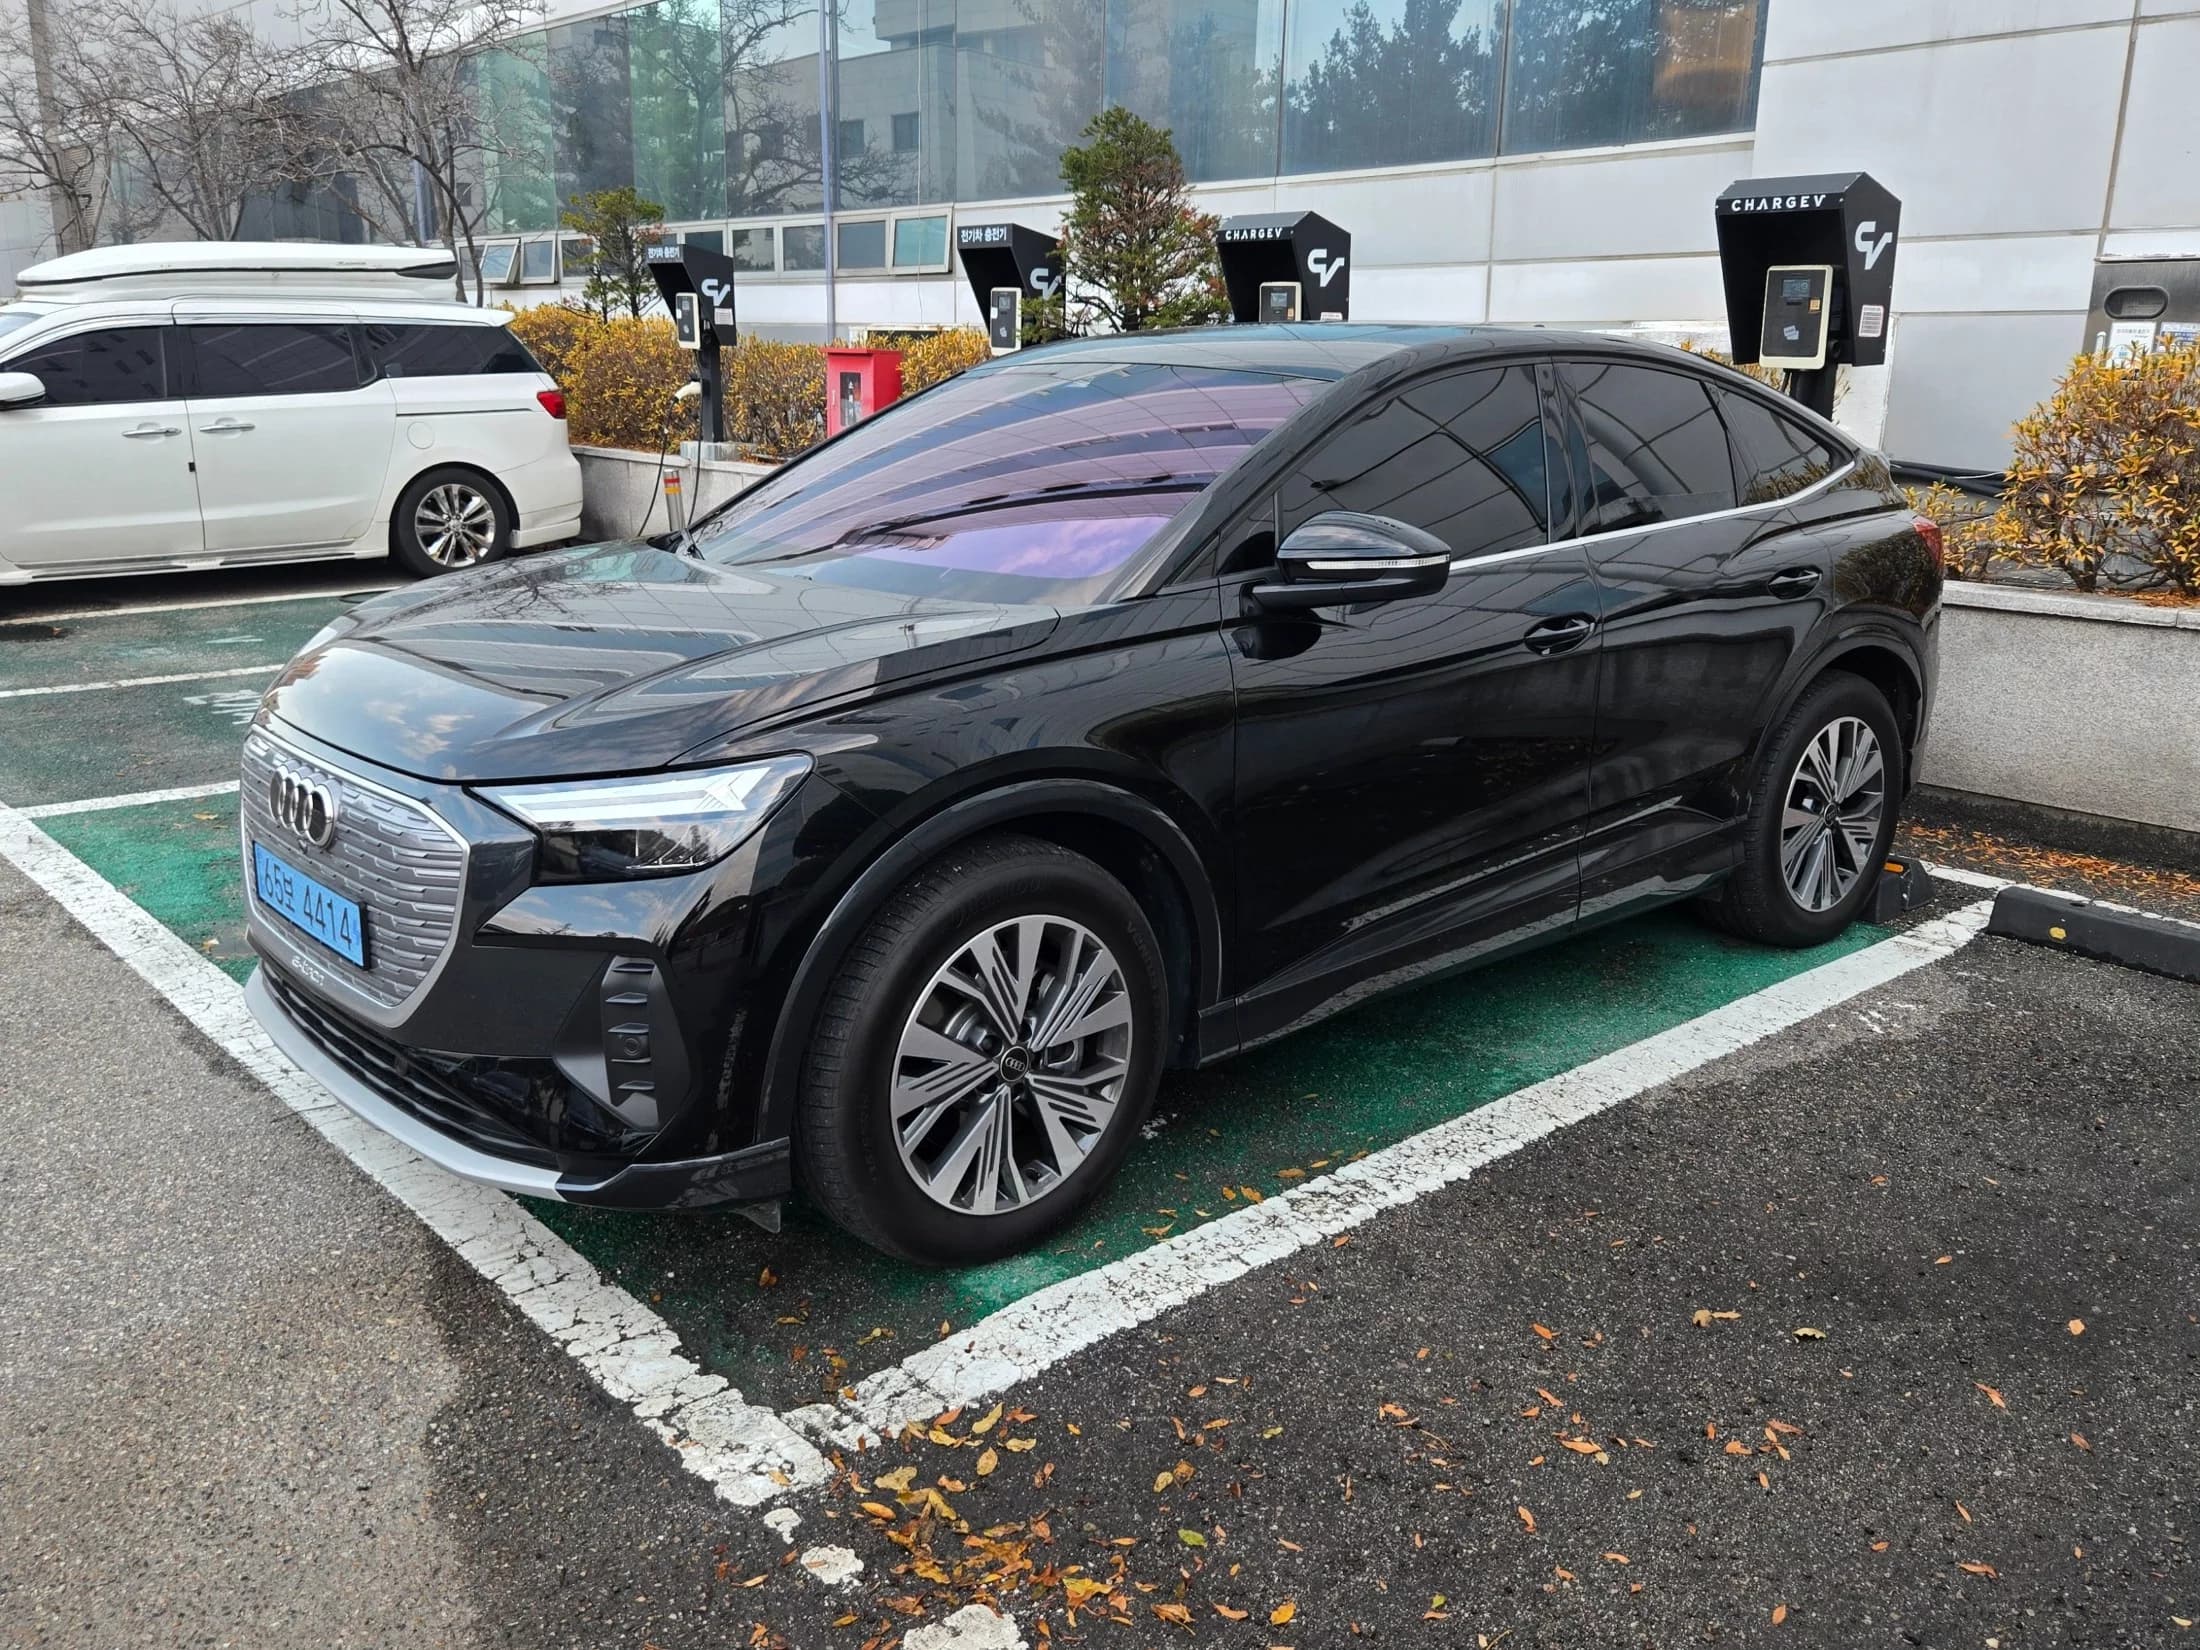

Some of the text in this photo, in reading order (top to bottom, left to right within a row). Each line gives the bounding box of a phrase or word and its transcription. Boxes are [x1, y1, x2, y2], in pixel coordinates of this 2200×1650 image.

[1731, 194, 1826, 212] CHARGEV
[961, 226, 1007, 243] 전기차 충전기
[1225, 227, 1283, 241] CHARGEV
[264, 857, 353, 952] 65보 4414
